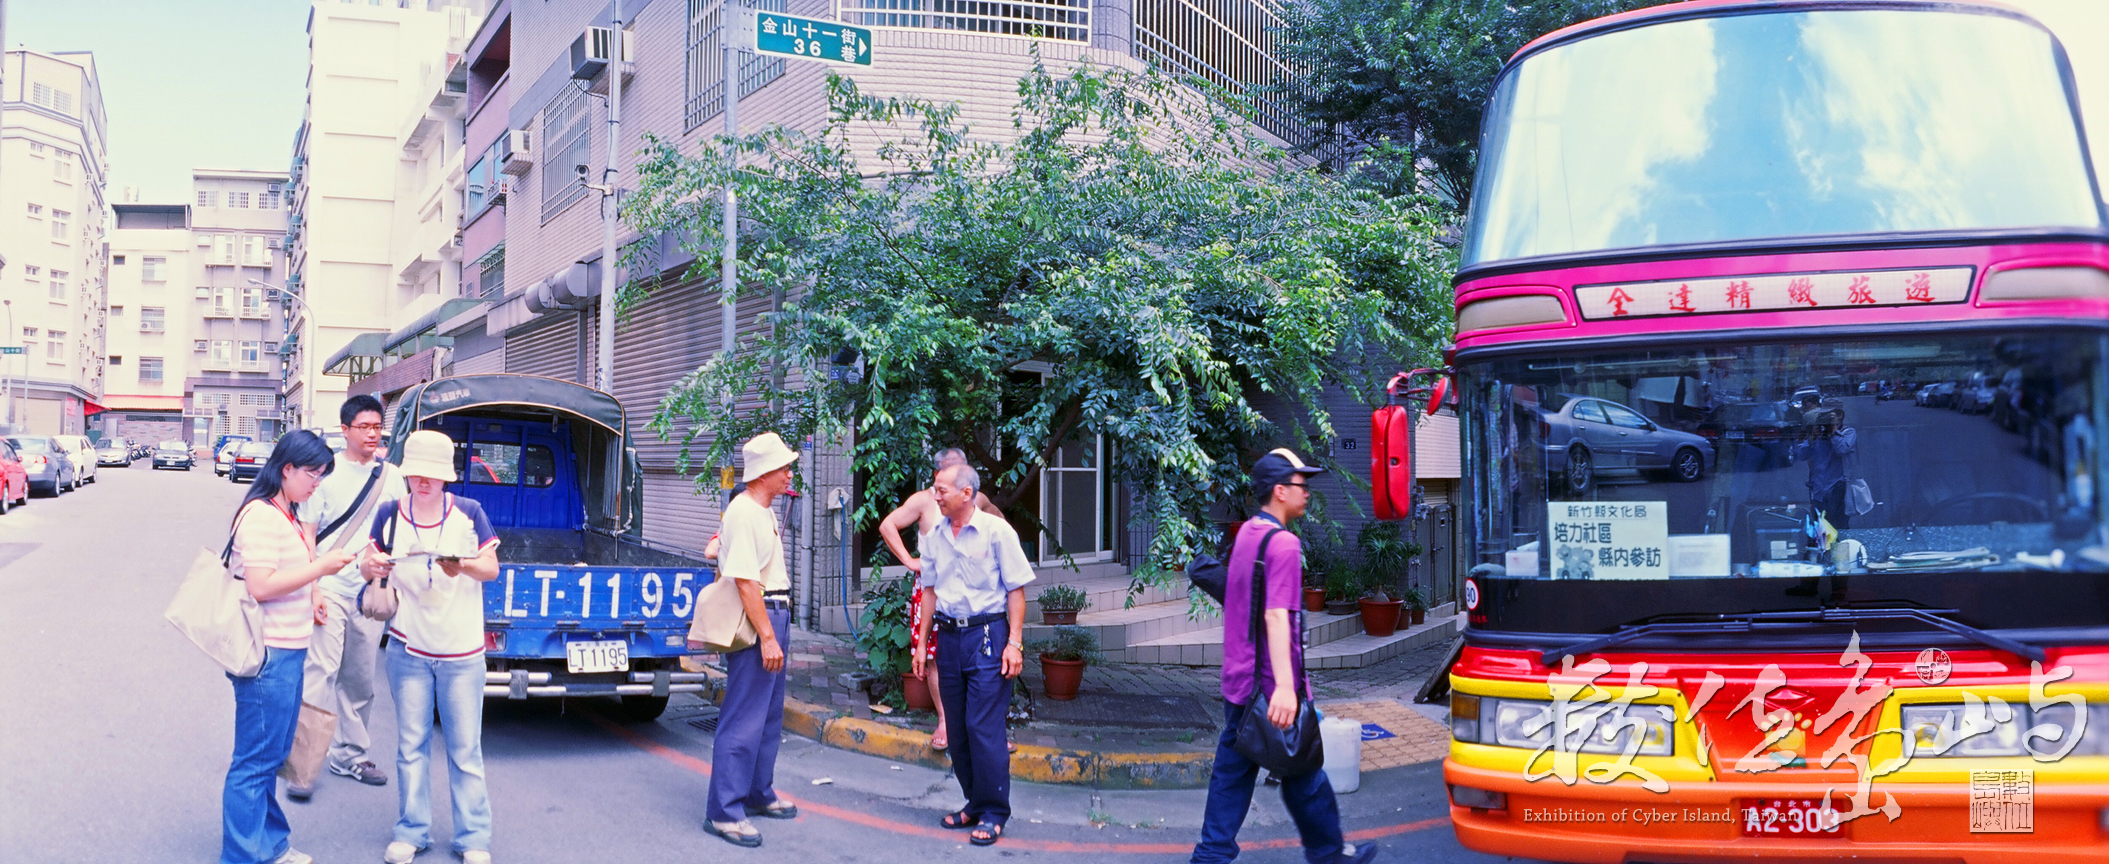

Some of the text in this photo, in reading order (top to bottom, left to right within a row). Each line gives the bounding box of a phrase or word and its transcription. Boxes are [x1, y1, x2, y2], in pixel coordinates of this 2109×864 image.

[762, 16, 857, 46] 金山十一街
[793, 38, 857, 63] 36 巷
[1607, 273, 1936, 317] 全達精緻旅遊
[1567, 505, 1647, 518] 新竹縣文化局
[1554, 522, 1612, 544] 培力社區
[1598, 547, 1661, 567] 縣內參訪
[1773, 800, 1812, 808] 台北市
[1746, 806, 1840, 833] A2-303
